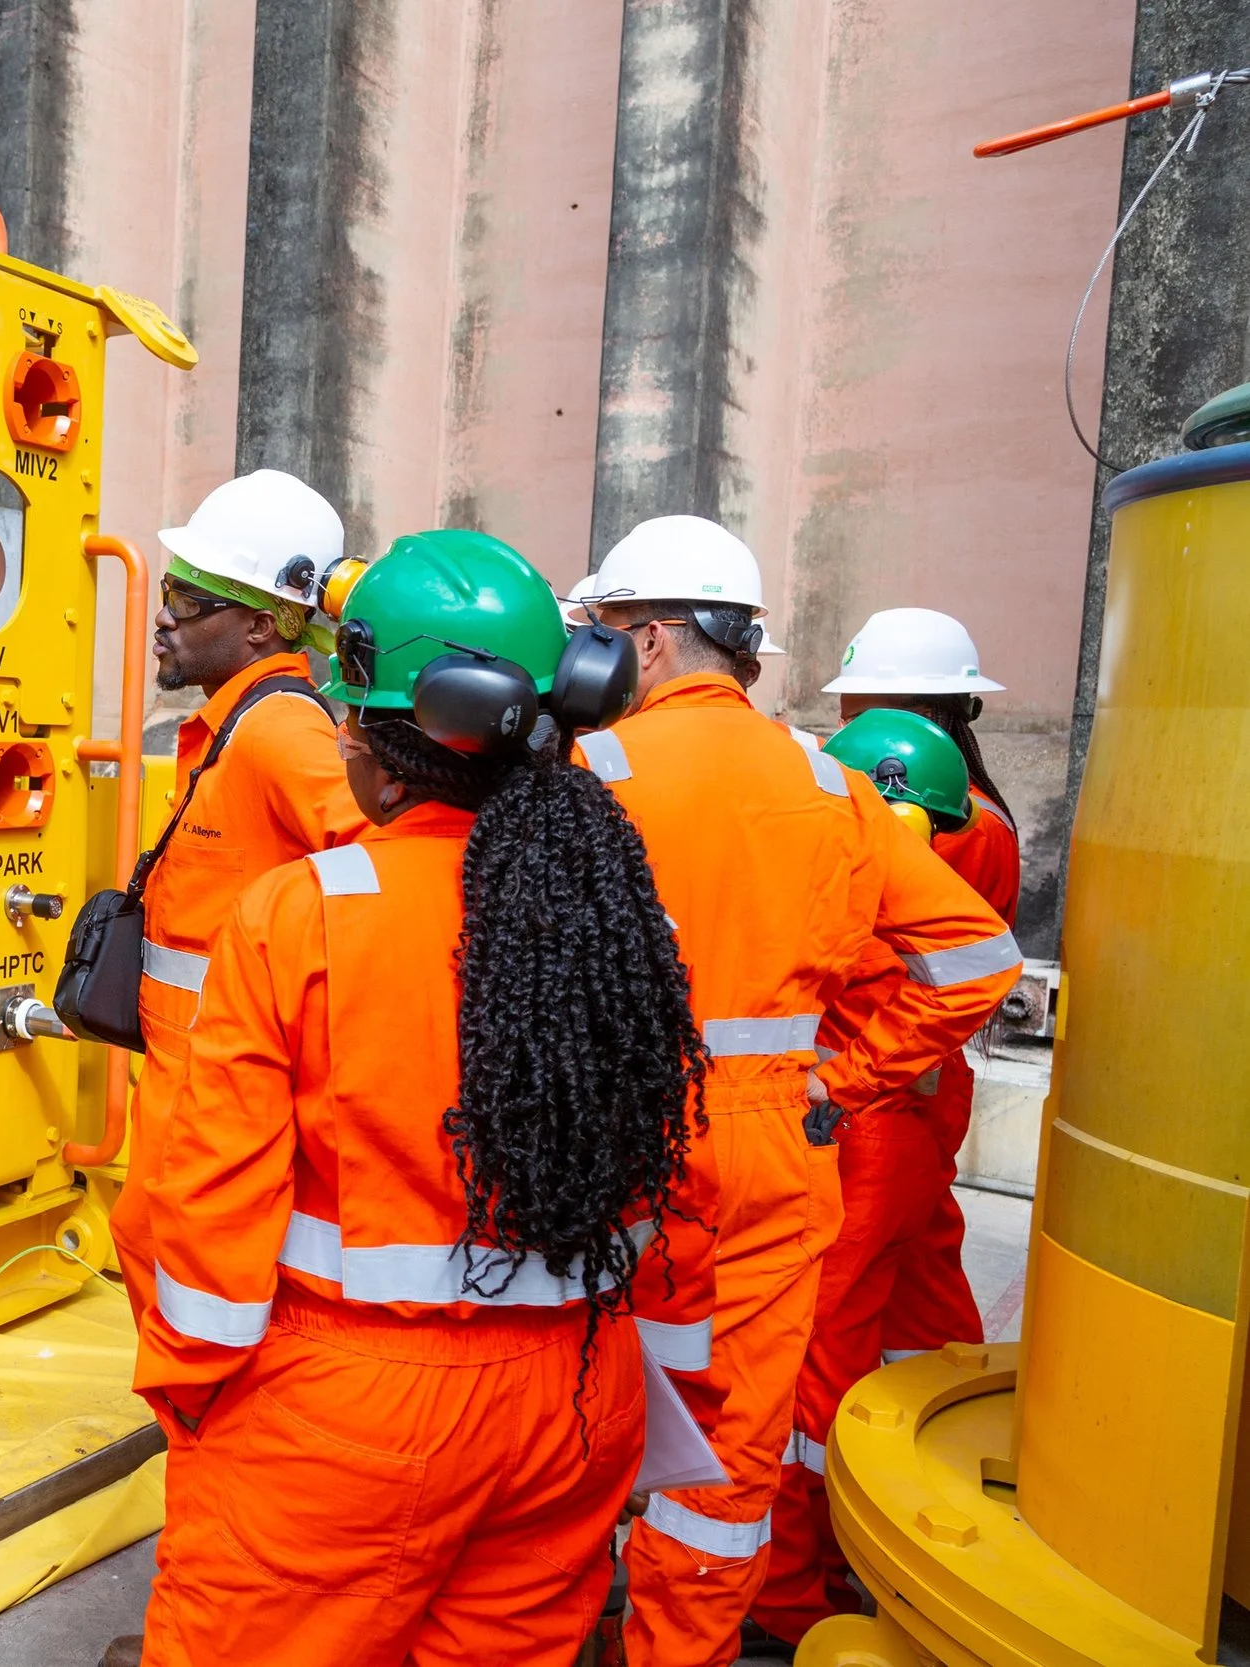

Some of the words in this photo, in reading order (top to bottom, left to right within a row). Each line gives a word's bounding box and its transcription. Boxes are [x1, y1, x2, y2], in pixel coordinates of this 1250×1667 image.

[18, 308, 25, 320] O
[57, 322, 63, 335] S
[15, 450, 58, 481] MIV2
